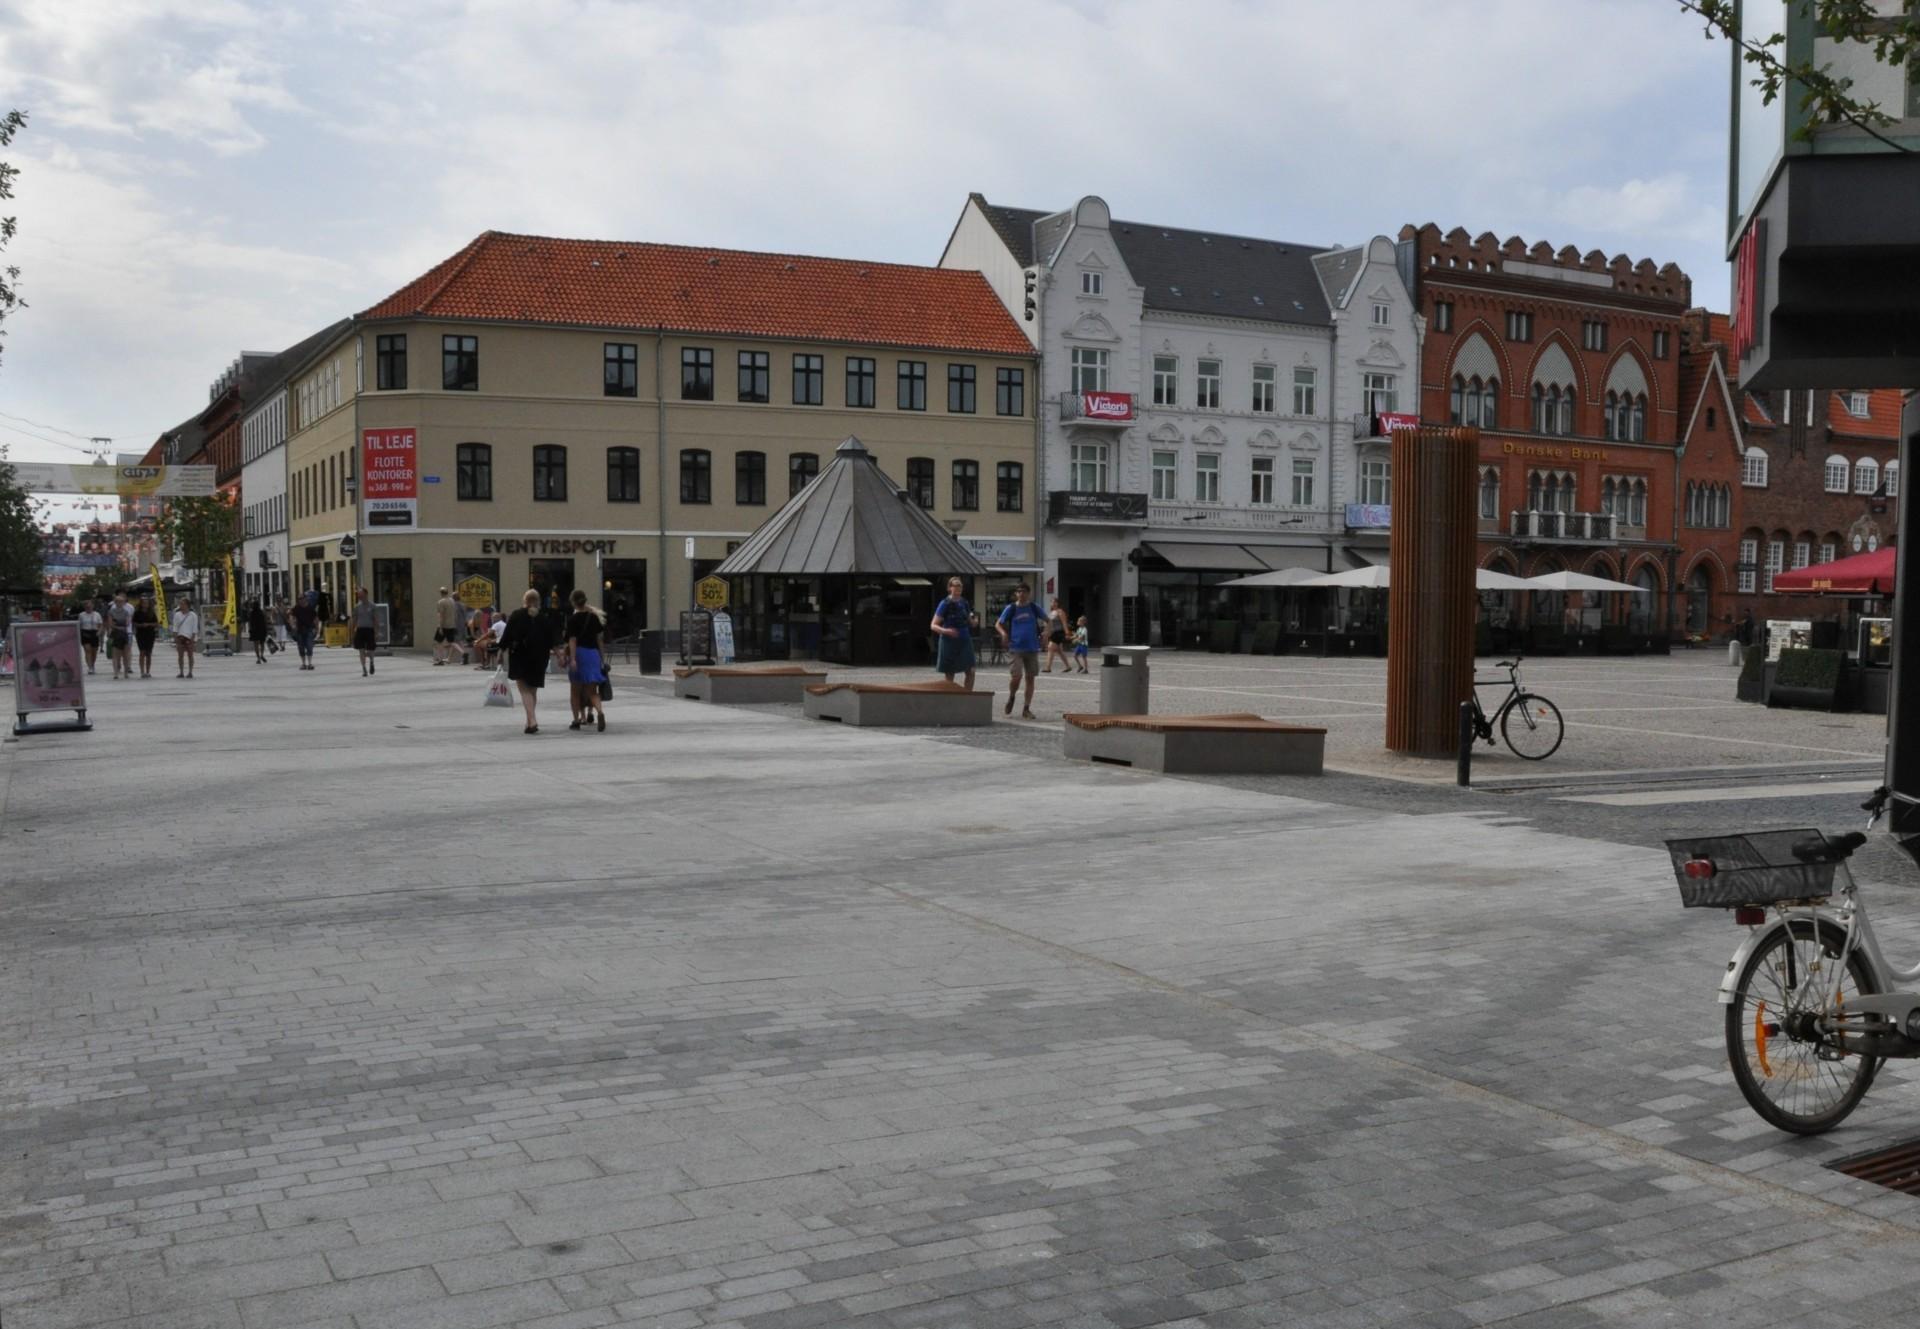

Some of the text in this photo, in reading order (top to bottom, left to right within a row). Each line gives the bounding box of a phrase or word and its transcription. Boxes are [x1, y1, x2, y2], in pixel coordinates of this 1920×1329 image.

[1087, 395, 1128, 411] Victoria
[367, 435, 414, 450] TIL LEJE
[1503, 441, 1609, 460] Danske Bank
[374, 456, 405, 468] FLOTTE
[367, 469, 413, 481] KONTORER
[482, 539, 616, 554] EVENTYRSPORT
[970, 540, 994, 552] Mary
[702, 590, 723, 600] 50%
